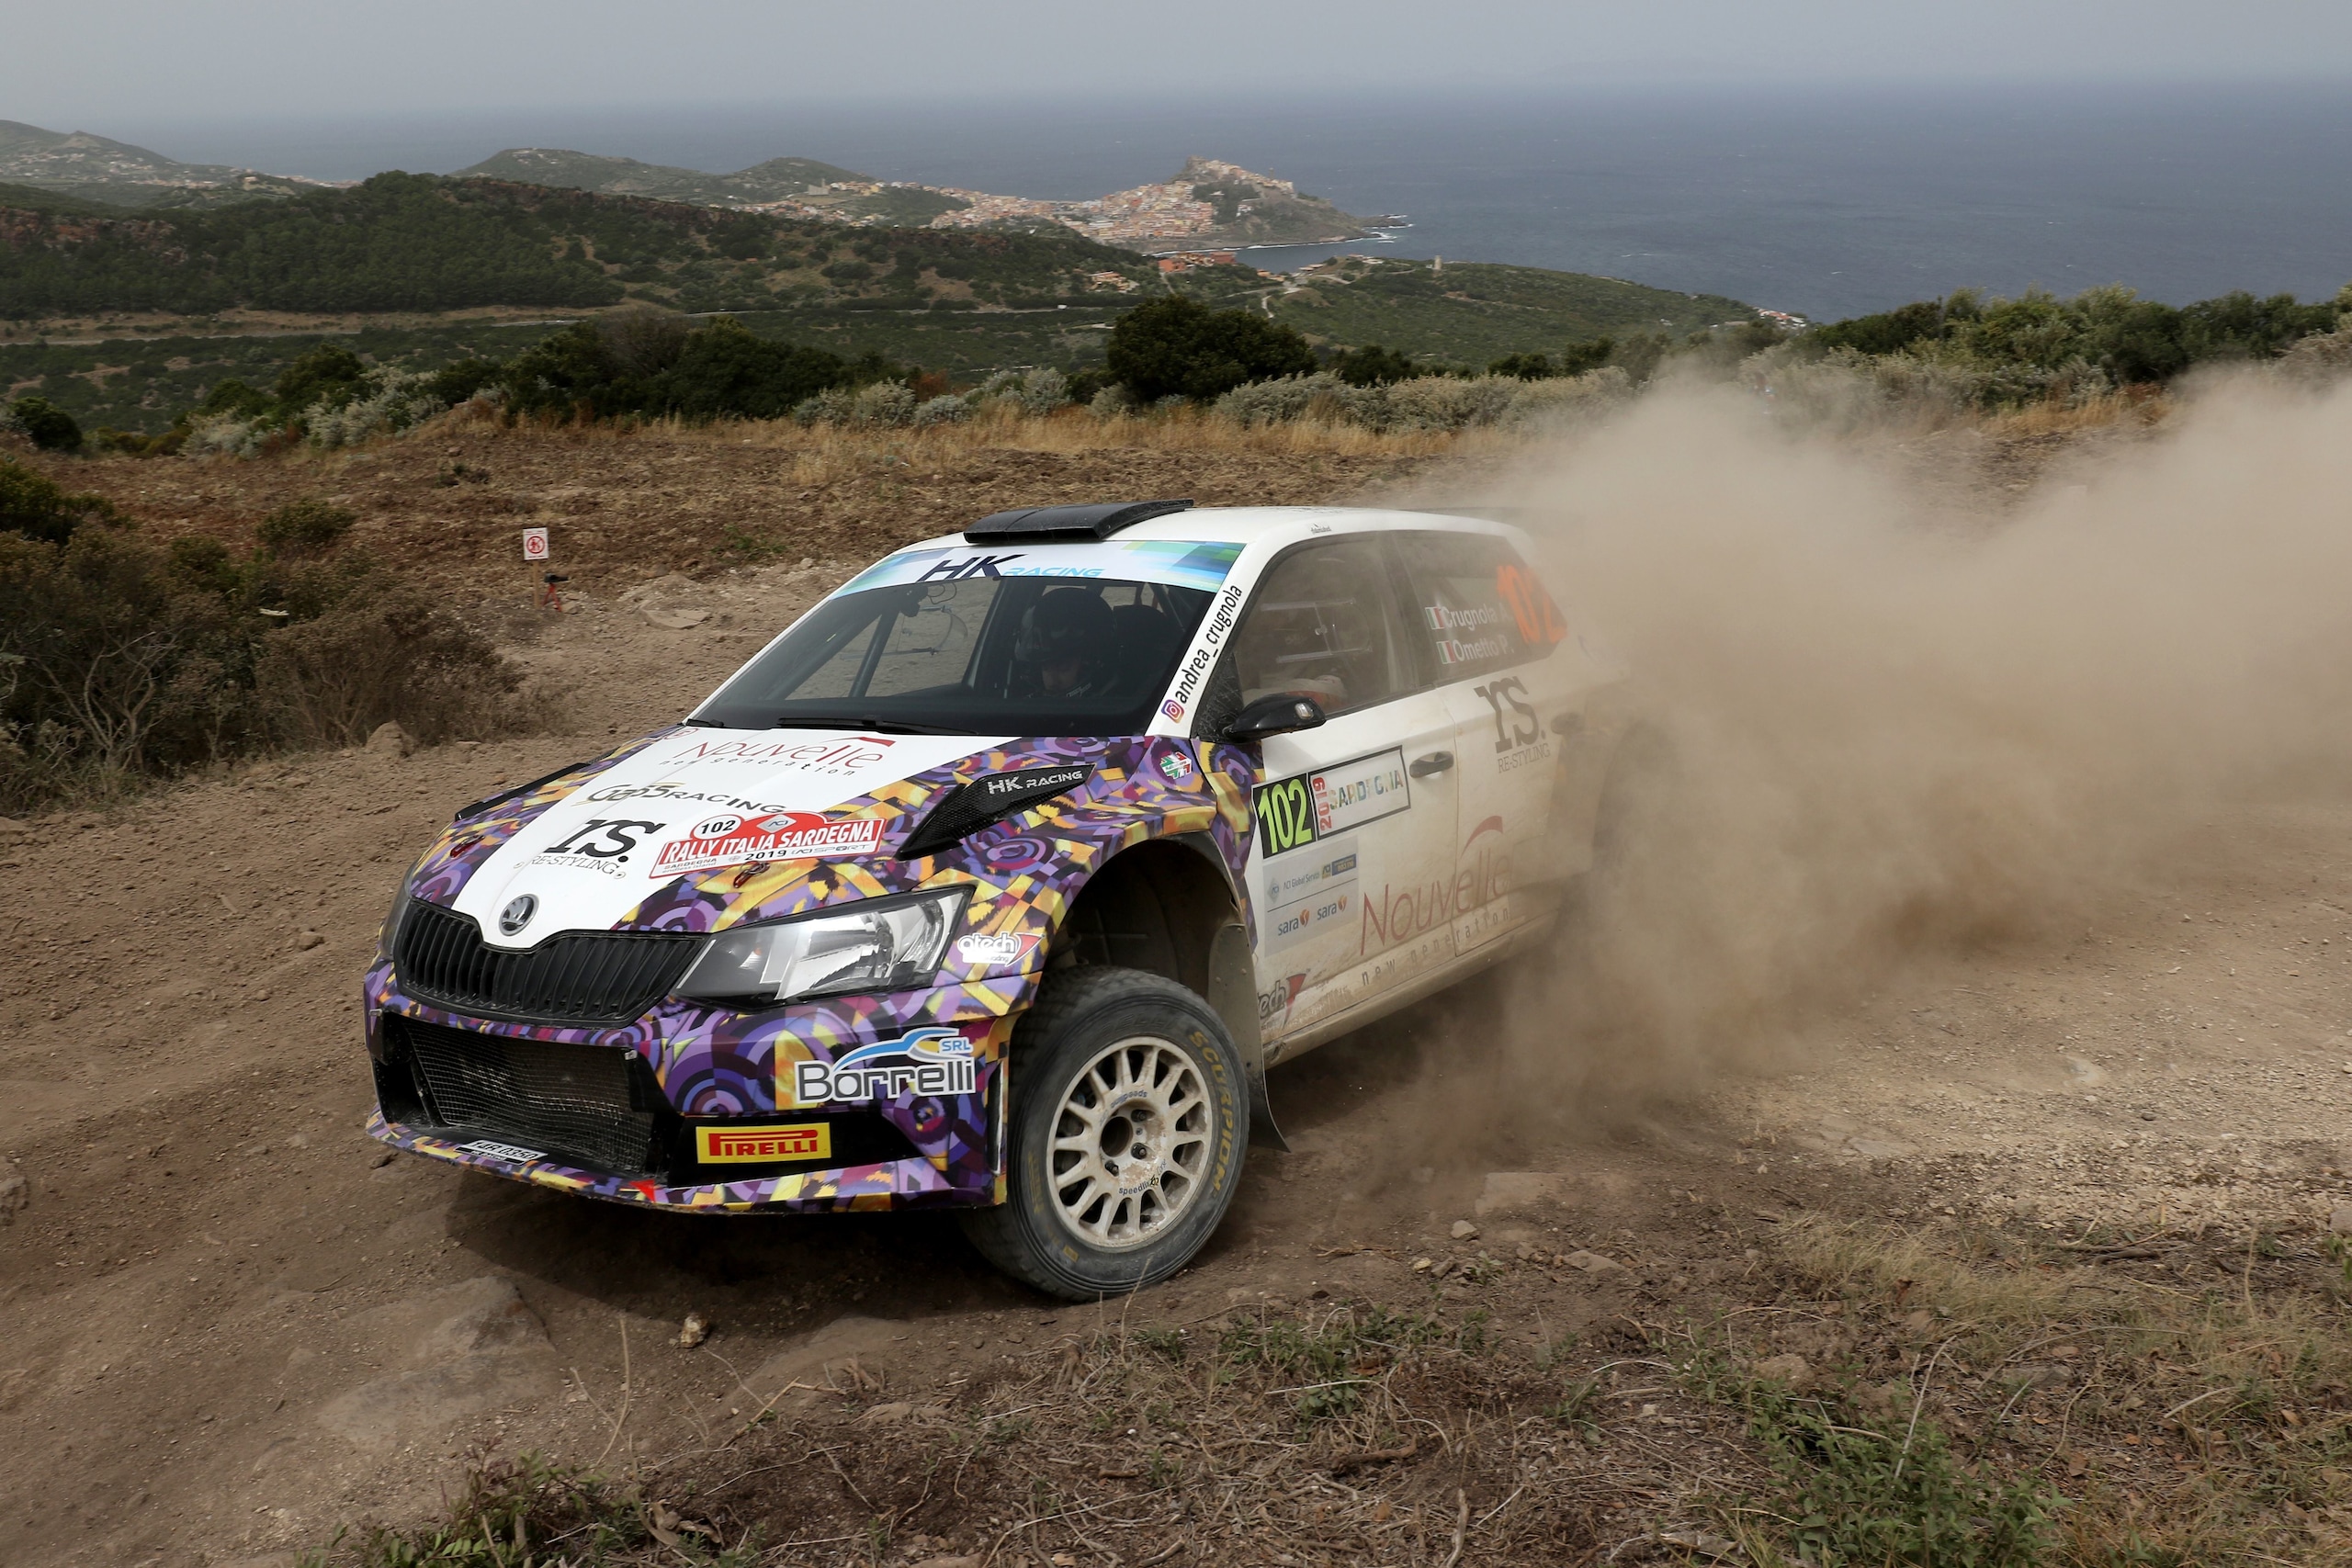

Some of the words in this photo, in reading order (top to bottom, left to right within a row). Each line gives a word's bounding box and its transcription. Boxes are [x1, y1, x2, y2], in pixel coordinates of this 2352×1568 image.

[917, 554, 1028, 582] HK
[1003, 567, 1106, 577] RACING
[1441, 604, 1498, 631] Crugnola
[1174, 584, 1243, 706] andrea_crugnola
[1453, 638, 1499, 661] Ometto
[673, 739, 884, 769] Nouvelle
[709, 756, 856, 776] generation
[1498, 742, 1552, 773] RE-STYLING
[988, 776, 1023, 795] HK
[1026, 770, 1084, 789] RACING
[1258, 778, 1313, 854] 102
[1312, 776, 1332, 832] 2019
[699, 819, 736, 835] 102
[663, 839, 722, 863] RALLY
[719, 833, 775, 855] ITALIA
[776, 819, 875, 850] SARDEGNA
[531, 855, 620, 875] RE-STYLING
[744, 849, 787, 862] 2019
[1317, 902, 1337, 920] sara
[1360, 847, 1512, 956] Nouvelle
[1278, 917, 1299, 936] sara
[941, 1038, 972, 1052] SRL
[797, 1056, 975, 1101] Borrelli
[708, 1129, 819, 1157] PIRELLI
